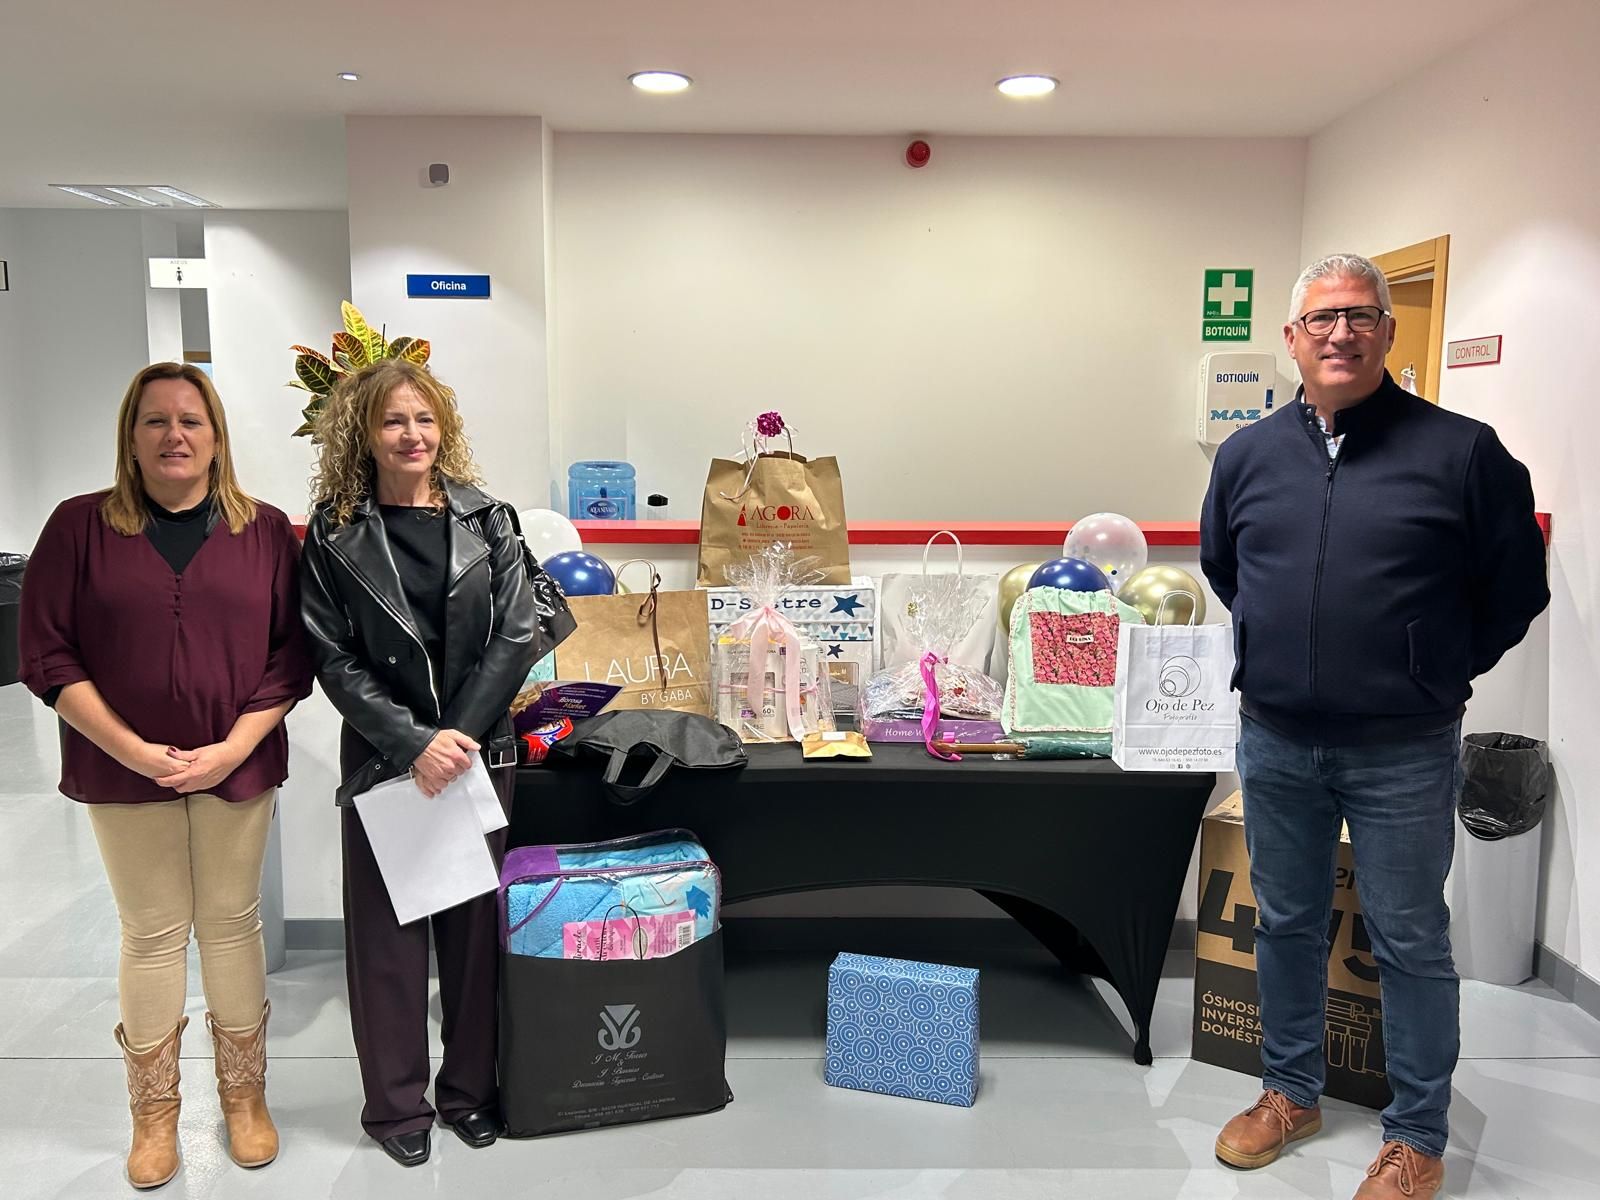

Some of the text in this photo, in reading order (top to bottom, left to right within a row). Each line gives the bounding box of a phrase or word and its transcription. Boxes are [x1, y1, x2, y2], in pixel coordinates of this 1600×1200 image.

[431, 281, 467, 290] Oficina
[1205, 325, 1248, 336] BOTIQUÍN
[1455, 344, 1490, 359] CONTROL
[1216, 371, 1259, 383] BOTIQUÍN
[1210, 409, 1261, 421] MAZ
[750, 505, 814, 522] AGORA
[641, 689, 692, 705] BY GABA
[1145, 699, 1215, 713] Ojo de Pez
[885, 727, 913, 737] Home
[1138, 747, 1222, 757] www.ojodepezfoto.es
[1202, 990, 1260, 1017] ÓSMOSI
[1202, 1006, 1263, 1032] INVERSA
[1201, 1020, 1265, 1046] DOMÉST
